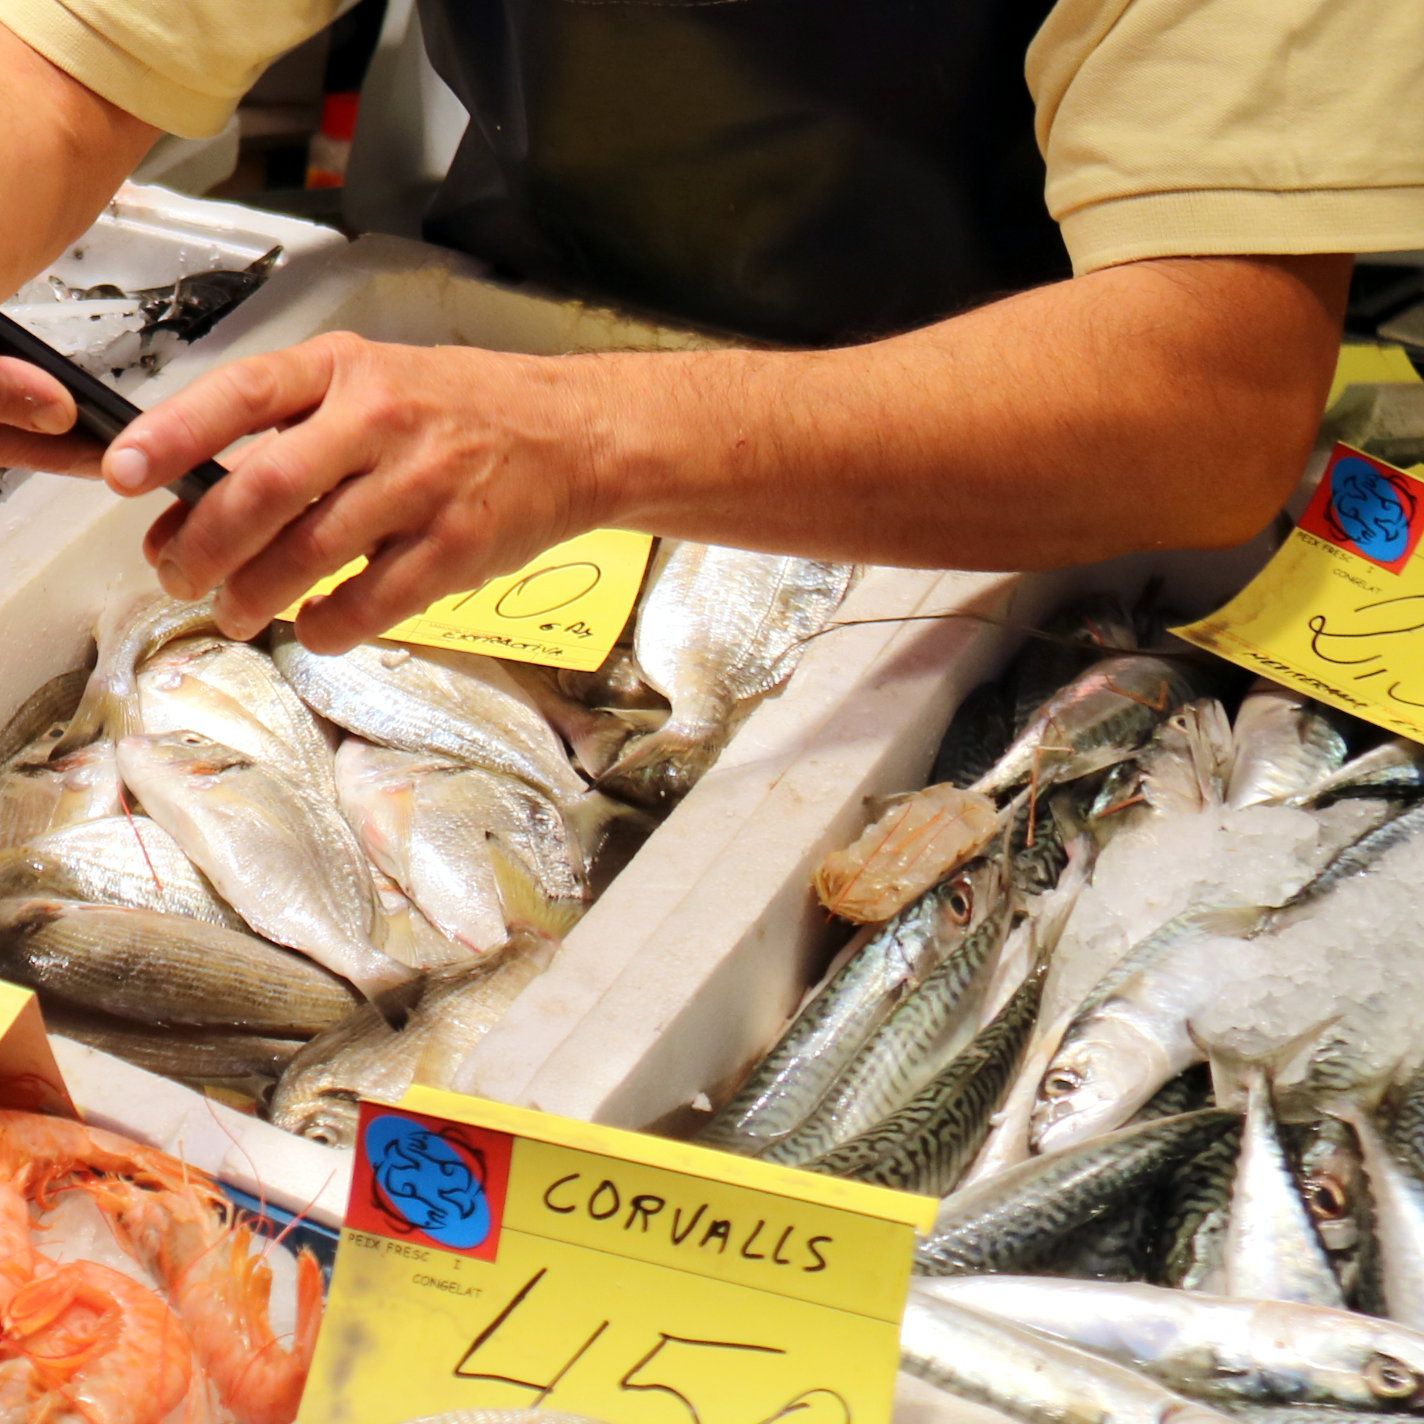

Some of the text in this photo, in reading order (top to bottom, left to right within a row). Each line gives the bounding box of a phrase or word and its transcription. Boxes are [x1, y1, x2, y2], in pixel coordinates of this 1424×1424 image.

[543, 1173, 834, 1273] CORVALLS
[347, 1233, 381, 1250] PEIX
[385, 1242, 430, 1262] FRESC
[412, 1273, 483, 1299] CONGELAT
